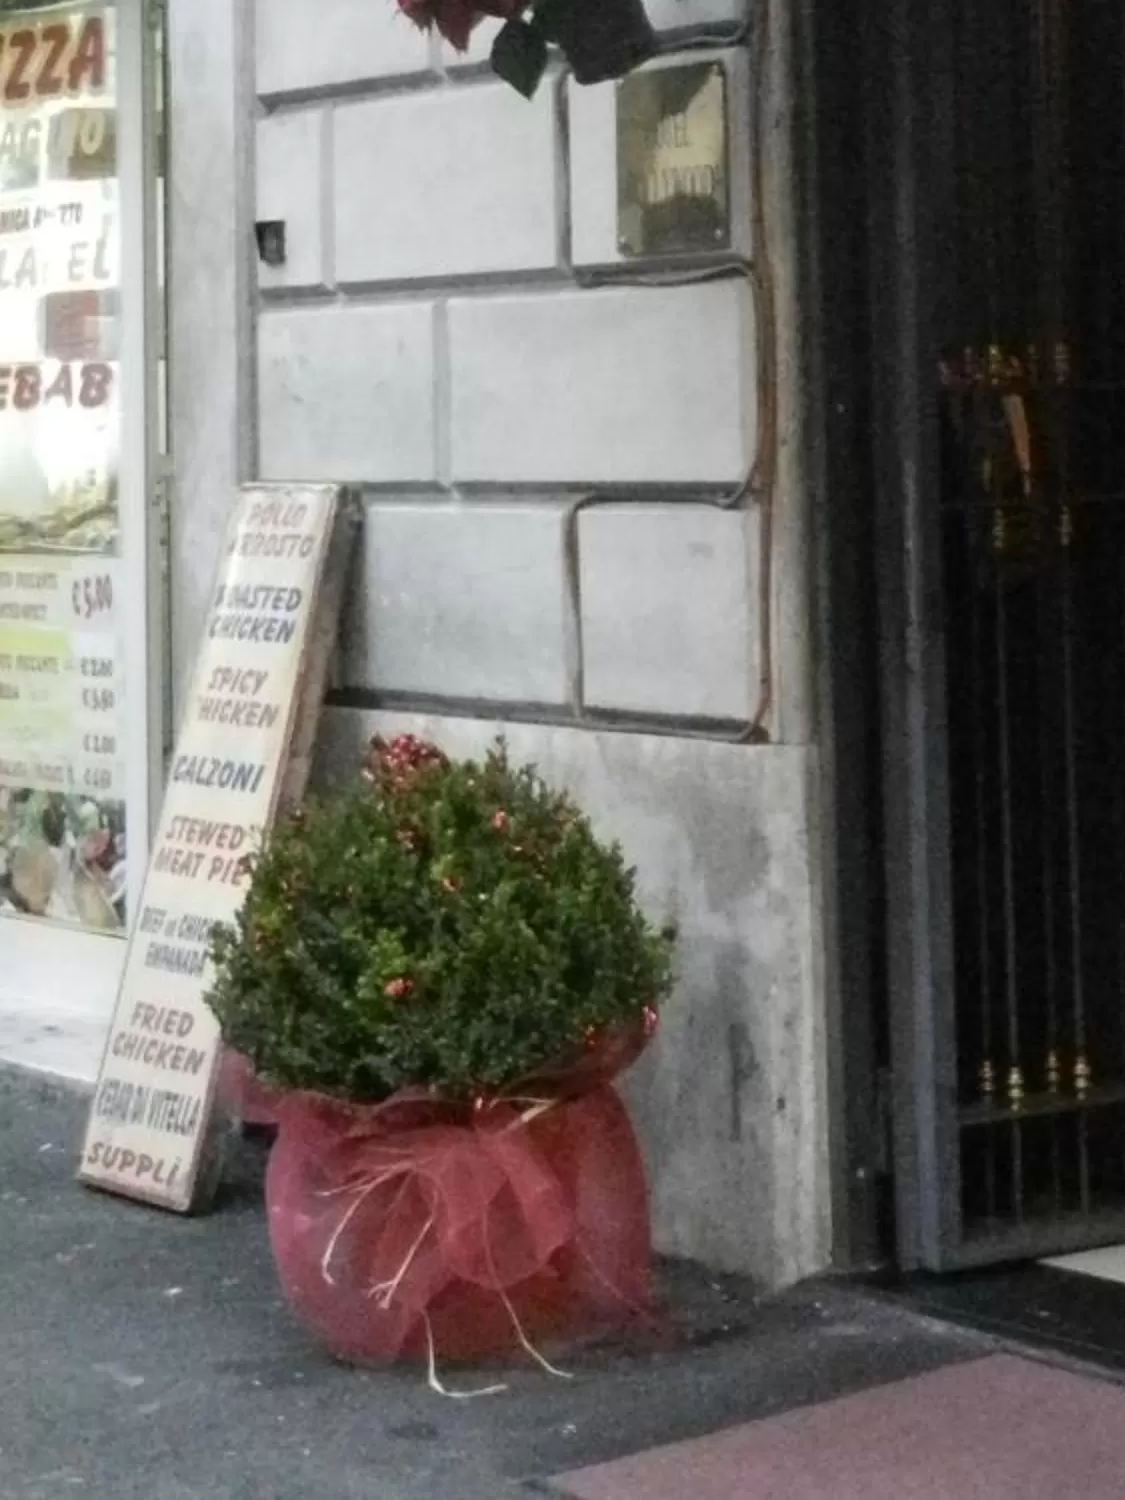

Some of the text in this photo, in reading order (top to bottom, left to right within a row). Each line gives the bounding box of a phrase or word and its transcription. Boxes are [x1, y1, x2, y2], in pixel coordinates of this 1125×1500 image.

[0, 16, 104, 101] ZZA
[209, 614, 296, 645] CHICKEN
[208, 665, 269, 696] SPICY
[198, 695, 280, 730] HICKEN
[172, 754, 266, 793] CALZONI
[165, 815, 246, 851] STEWED
[153, 847, 206, 880] MEAT
[130, 1001, 195, 1037] FRIED
[112, 1031, 206, 1076] CHICKEN
